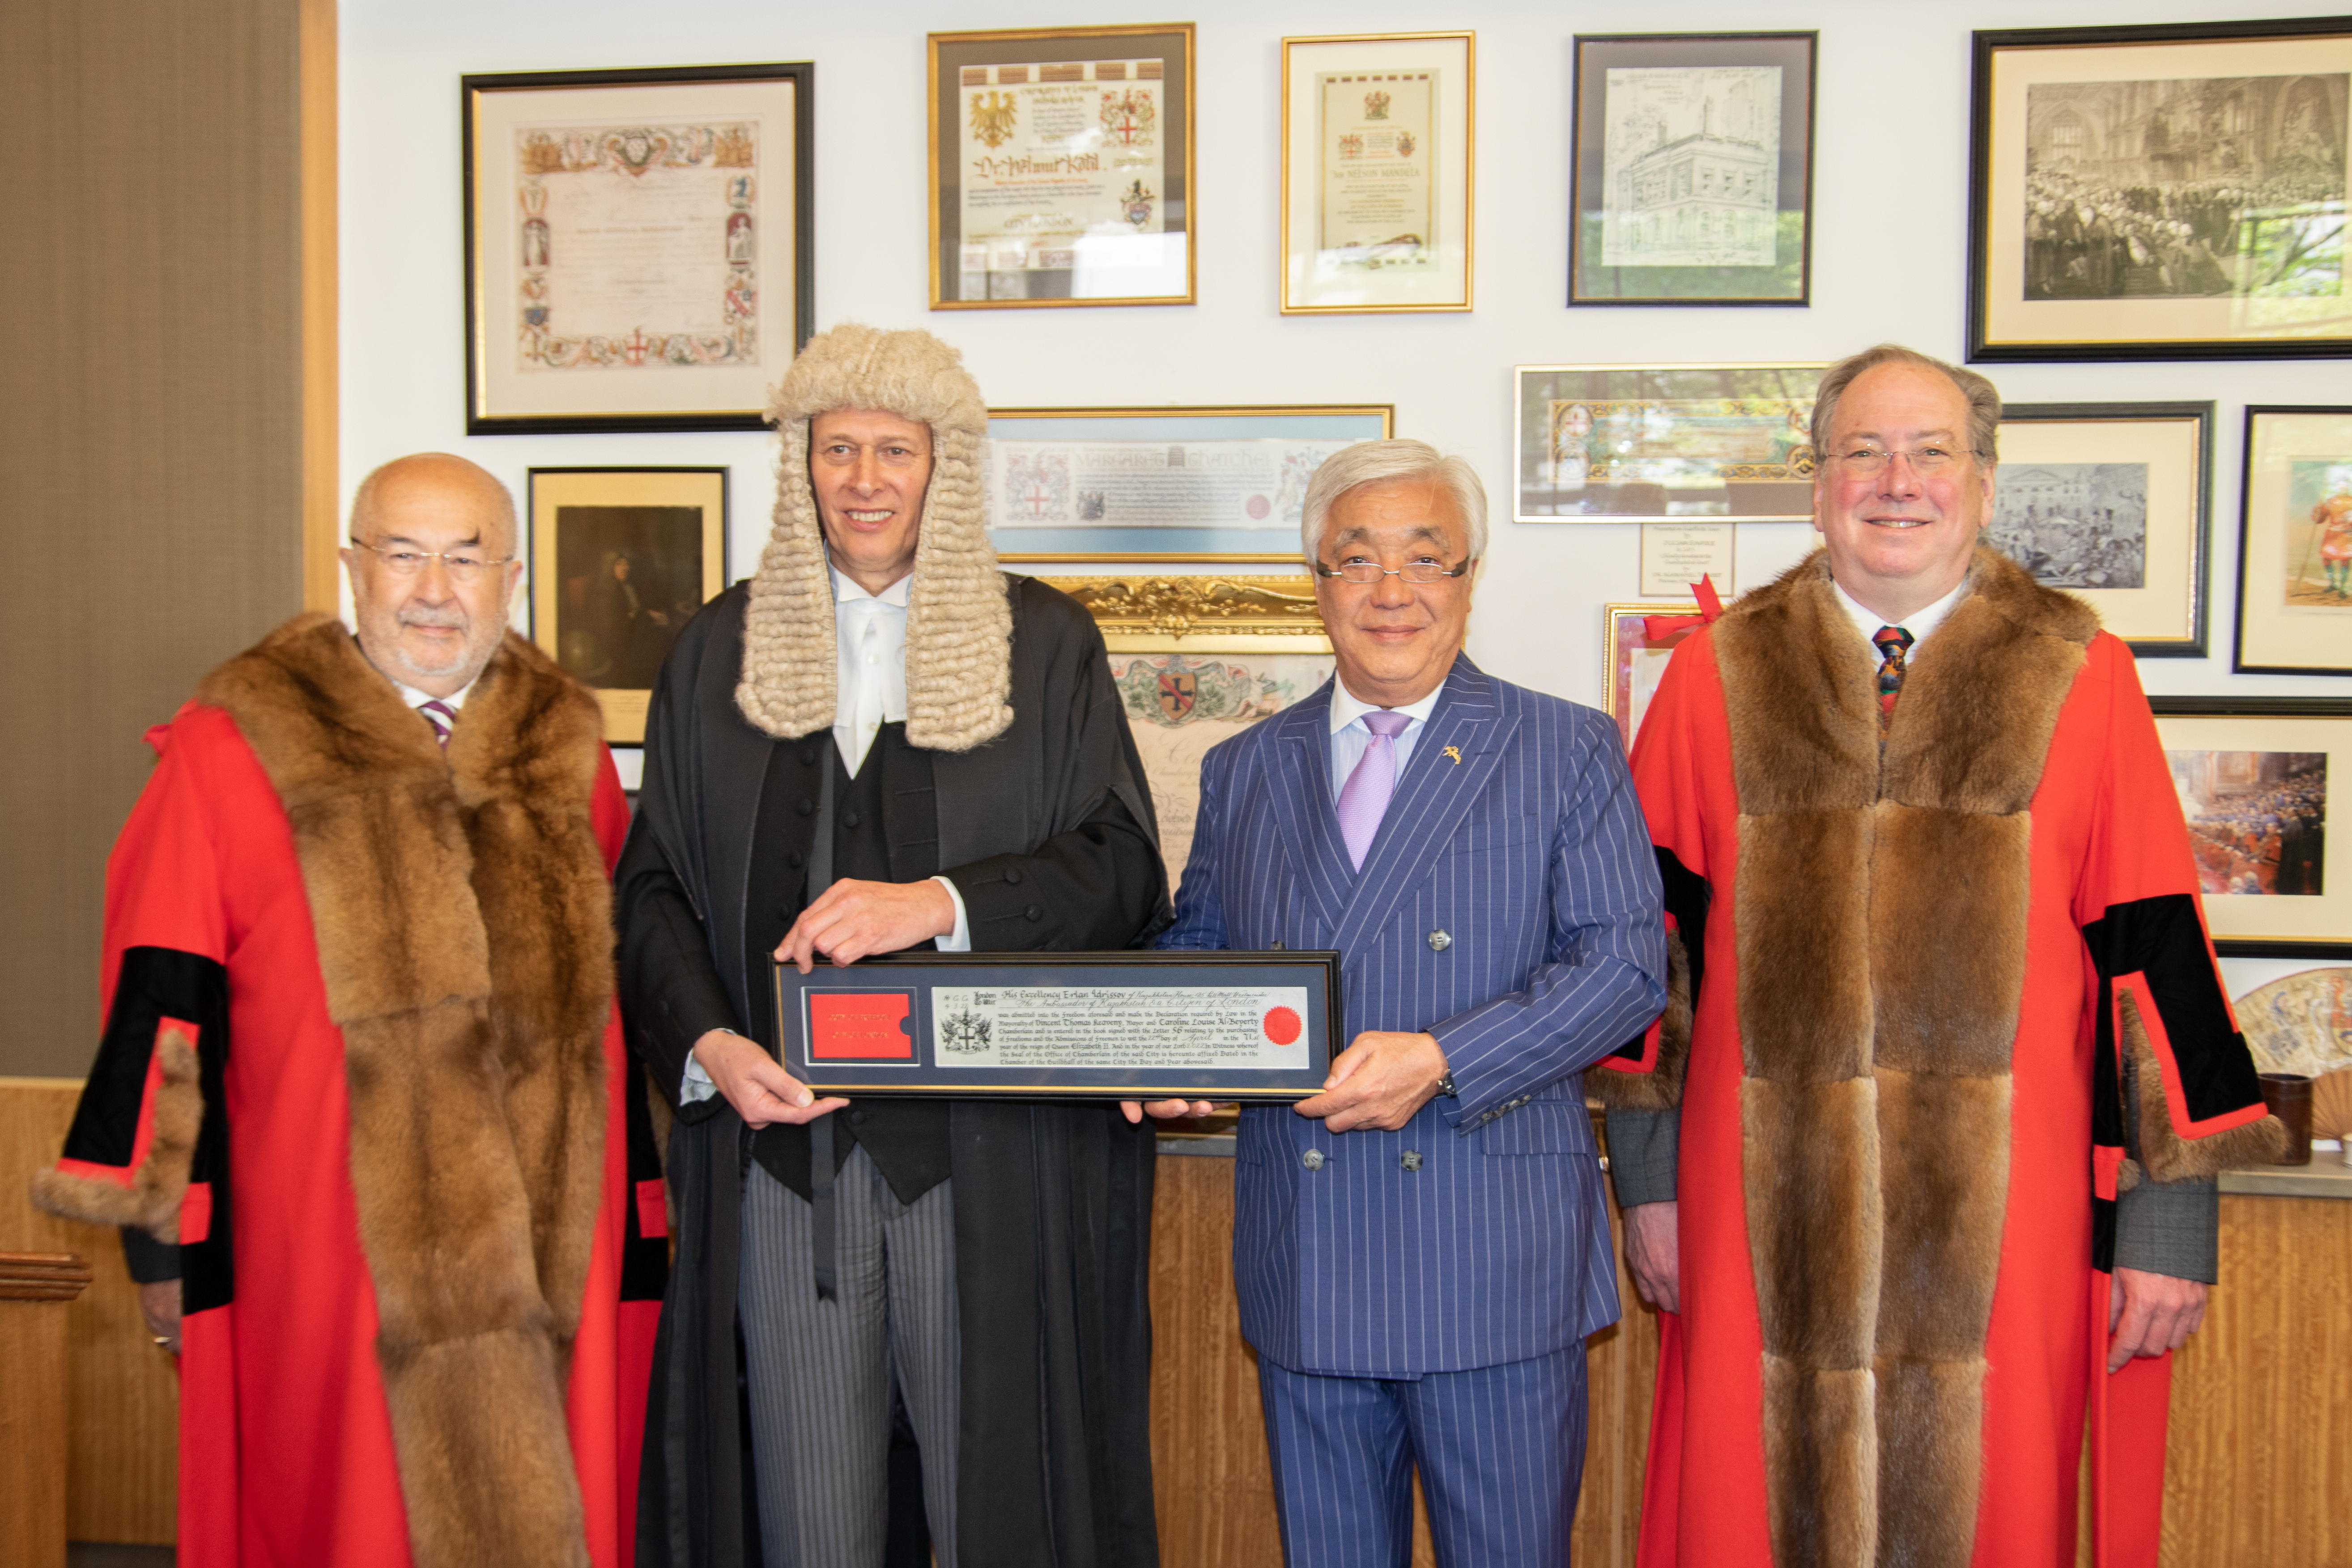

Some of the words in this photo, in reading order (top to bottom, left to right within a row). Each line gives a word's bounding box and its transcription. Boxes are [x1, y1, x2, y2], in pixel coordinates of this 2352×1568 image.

[1001, 989, 1017, 998] His
[1020, 990, 1060, 1000] Excellency
[1063, 990, 1088, 998] Erlan
[1092, 989, 1126, 998] Idrissov
[1219, 998, 1262, 1009] London
[1181, 1033, 1213, 1043] April
